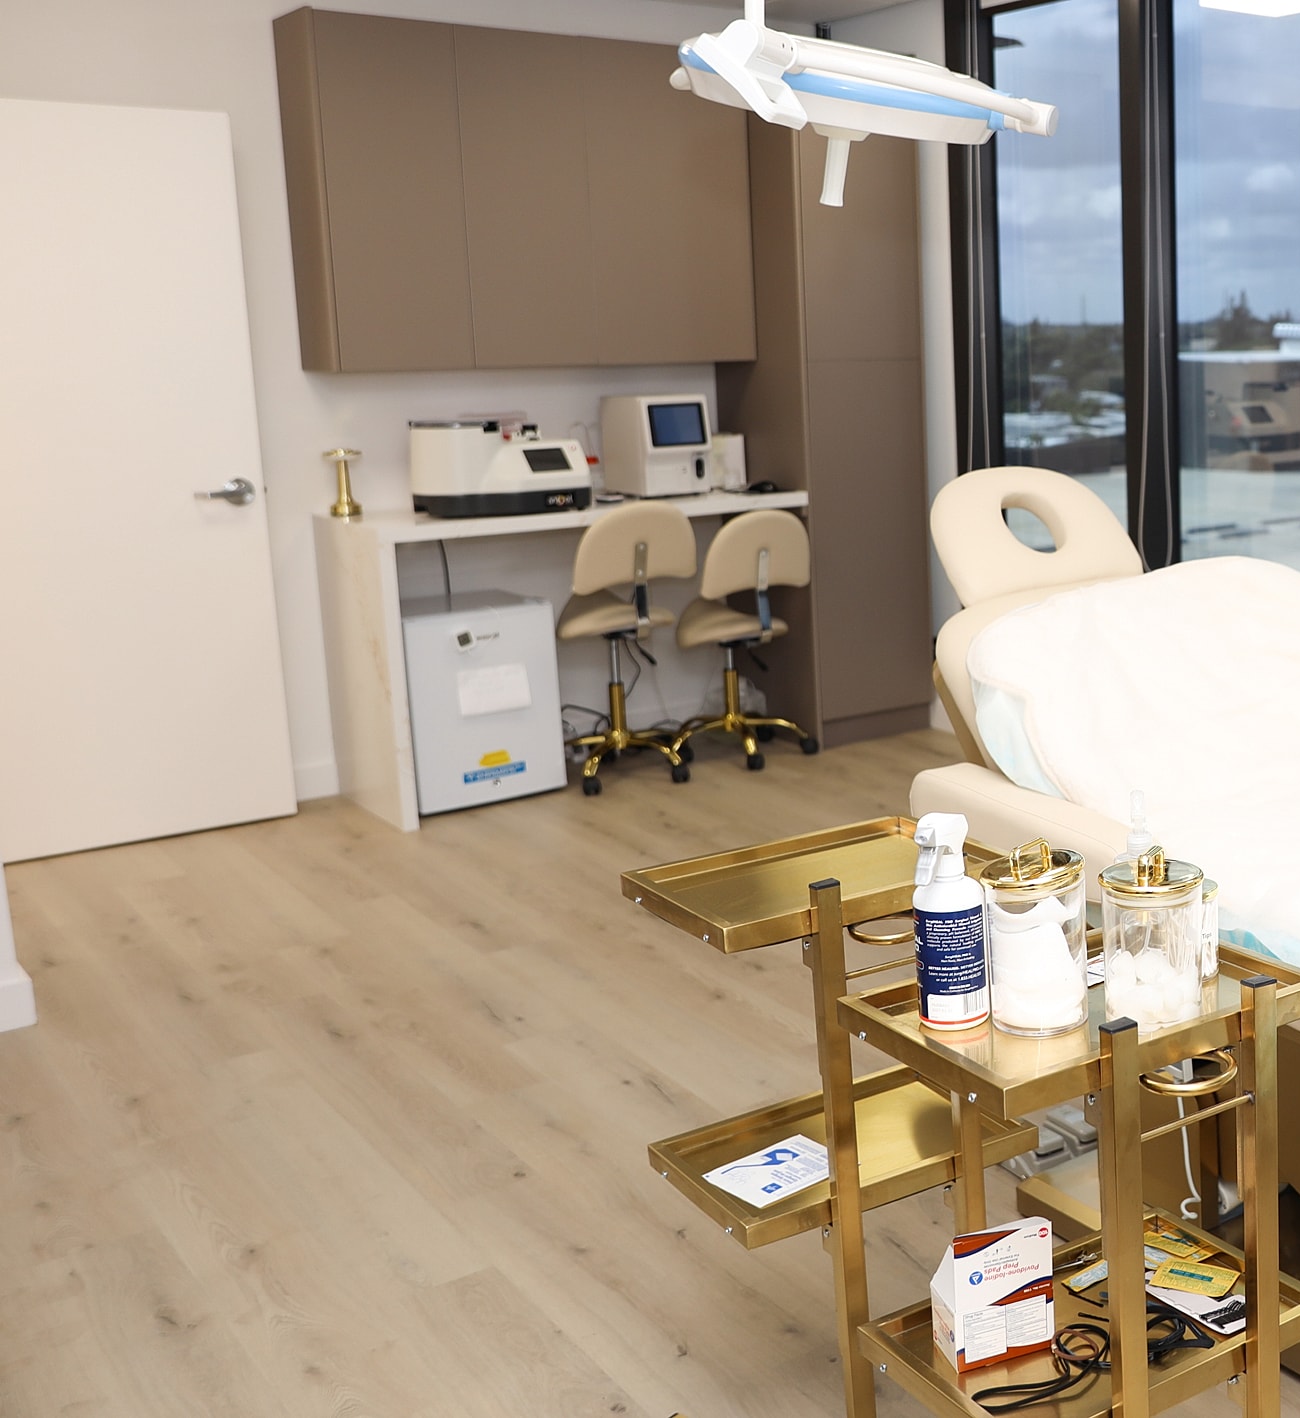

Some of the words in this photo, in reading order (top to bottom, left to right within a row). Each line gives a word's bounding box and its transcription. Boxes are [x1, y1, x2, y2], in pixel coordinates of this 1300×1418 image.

[1002, 1262, 1019, 1270] Prep
[984, 1267, 1001, 1275] Pads
[984, 1264, 1040, 1281] Povidone-Iodine
